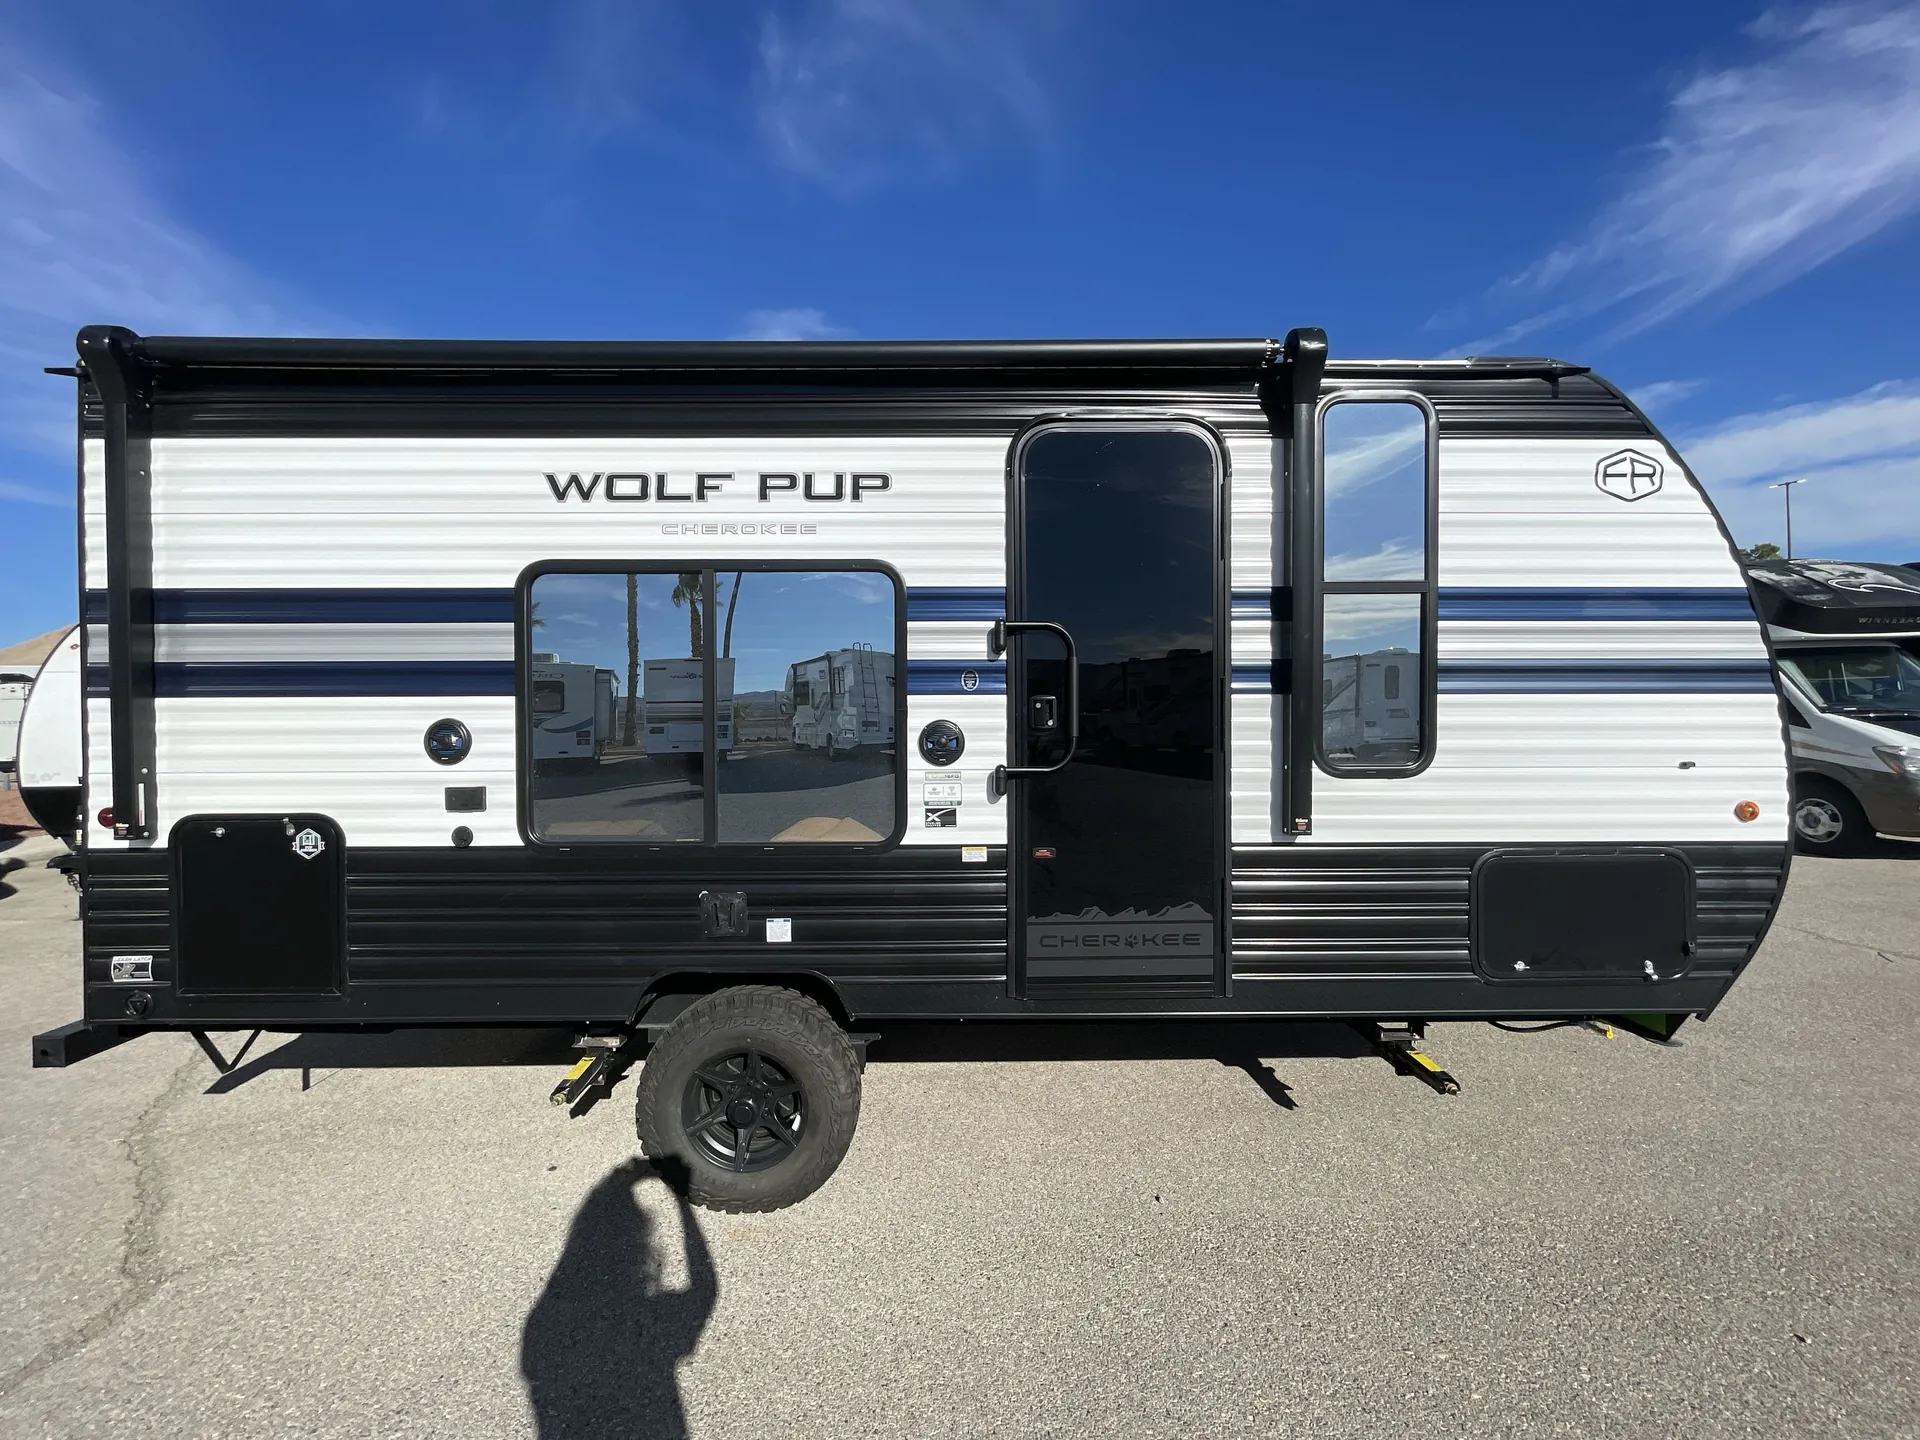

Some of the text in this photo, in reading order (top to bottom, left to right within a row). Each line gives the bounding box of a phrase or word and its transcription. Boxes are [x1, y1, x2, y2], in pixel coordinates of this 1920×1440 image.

[543, 472, 892, 502] WOLF PUP
[662, 523, 817, 535] CHEROKEE
